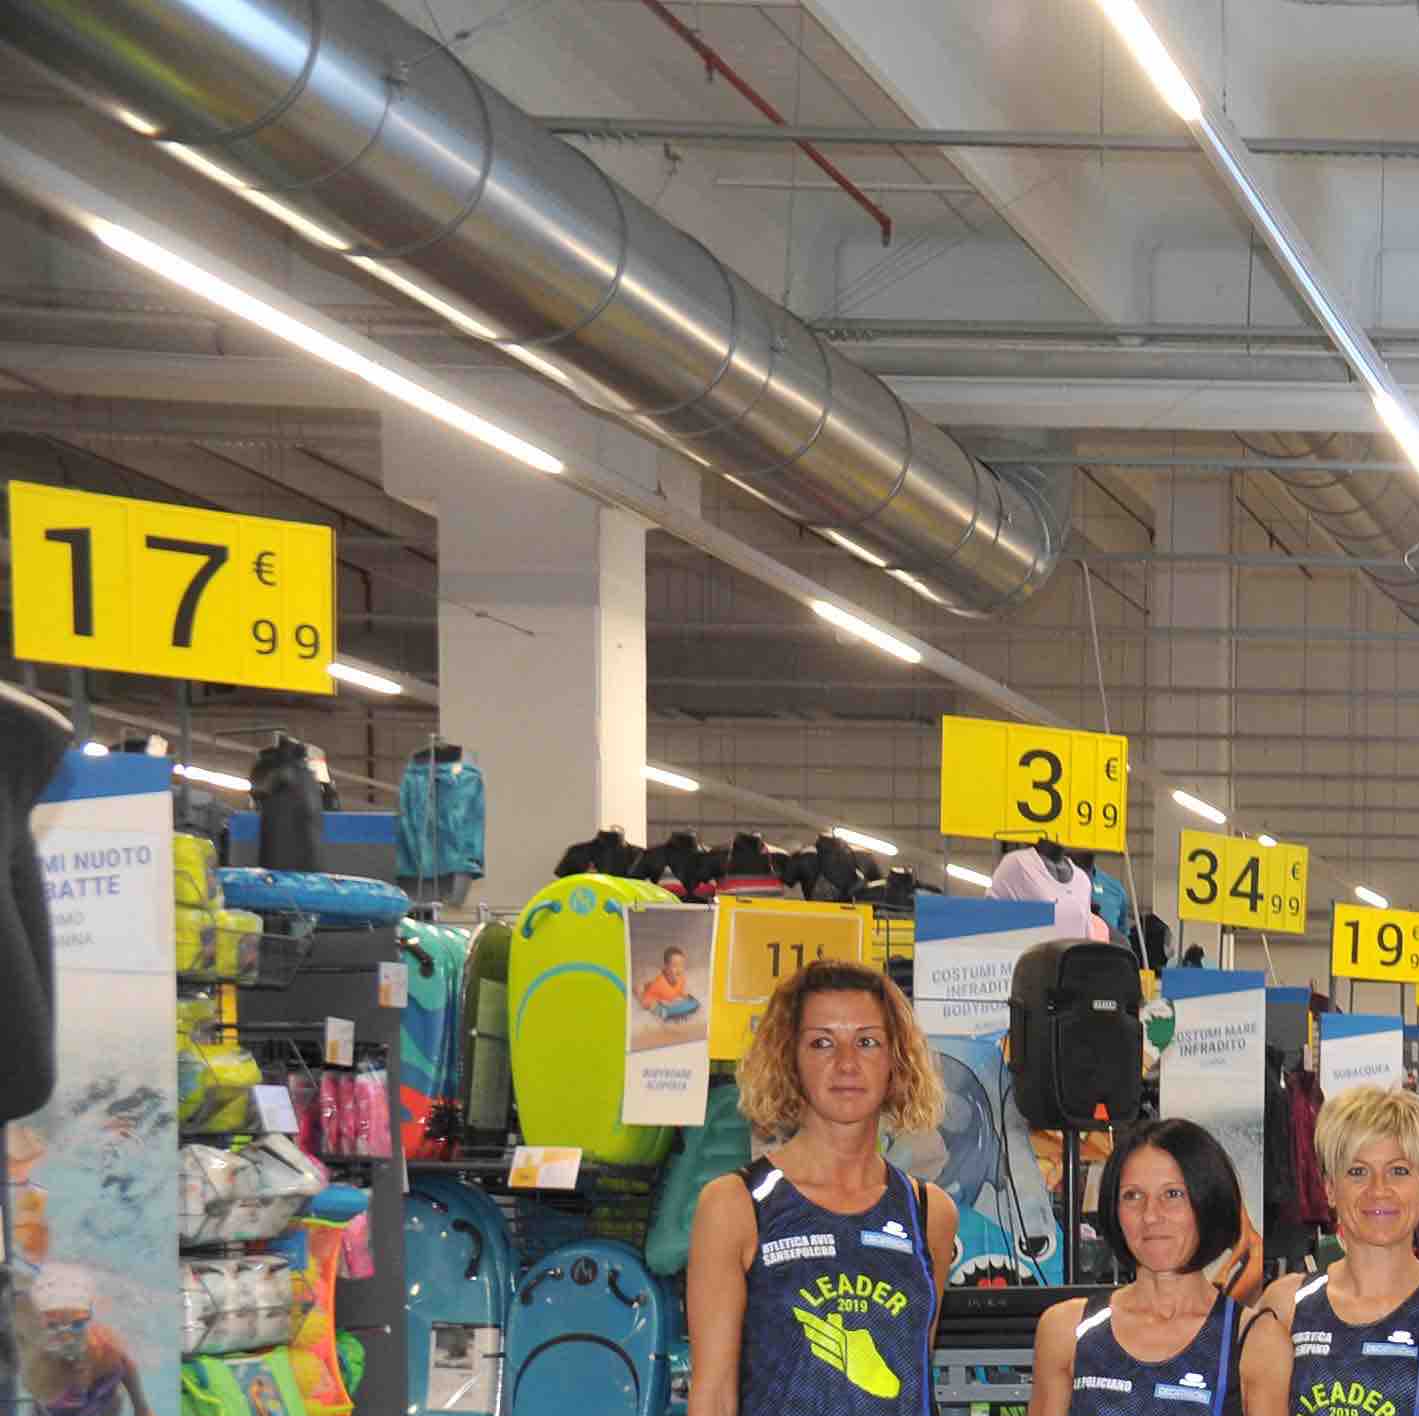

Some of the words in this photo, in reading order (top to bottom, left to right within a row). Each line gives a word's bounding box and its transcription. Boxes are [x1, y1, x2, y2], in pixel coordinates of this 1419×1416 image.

[252, 550, 277, 585] €
[45, 527, 229, 648] 17
[252, 619, 320, 660] 99
[1016, 748, 1063, 823] 3
[1104, 757, 1121, 782] €
[1076, 800, 1119, 828] 99
[74, 846, 151, 871] NUOTO
[1185, 848, 1264, 912] 34
[1270, 893, 1300, 915] 99
[1344, 918, 1404, 967] 19
[931, 961, 996, 984] COSTUMI
[1179, 1038, 1247, 1057] INFRADITO
[799, 1273, 908, 1318] LEADER
[837, 1297, 869, 1313] 2019
